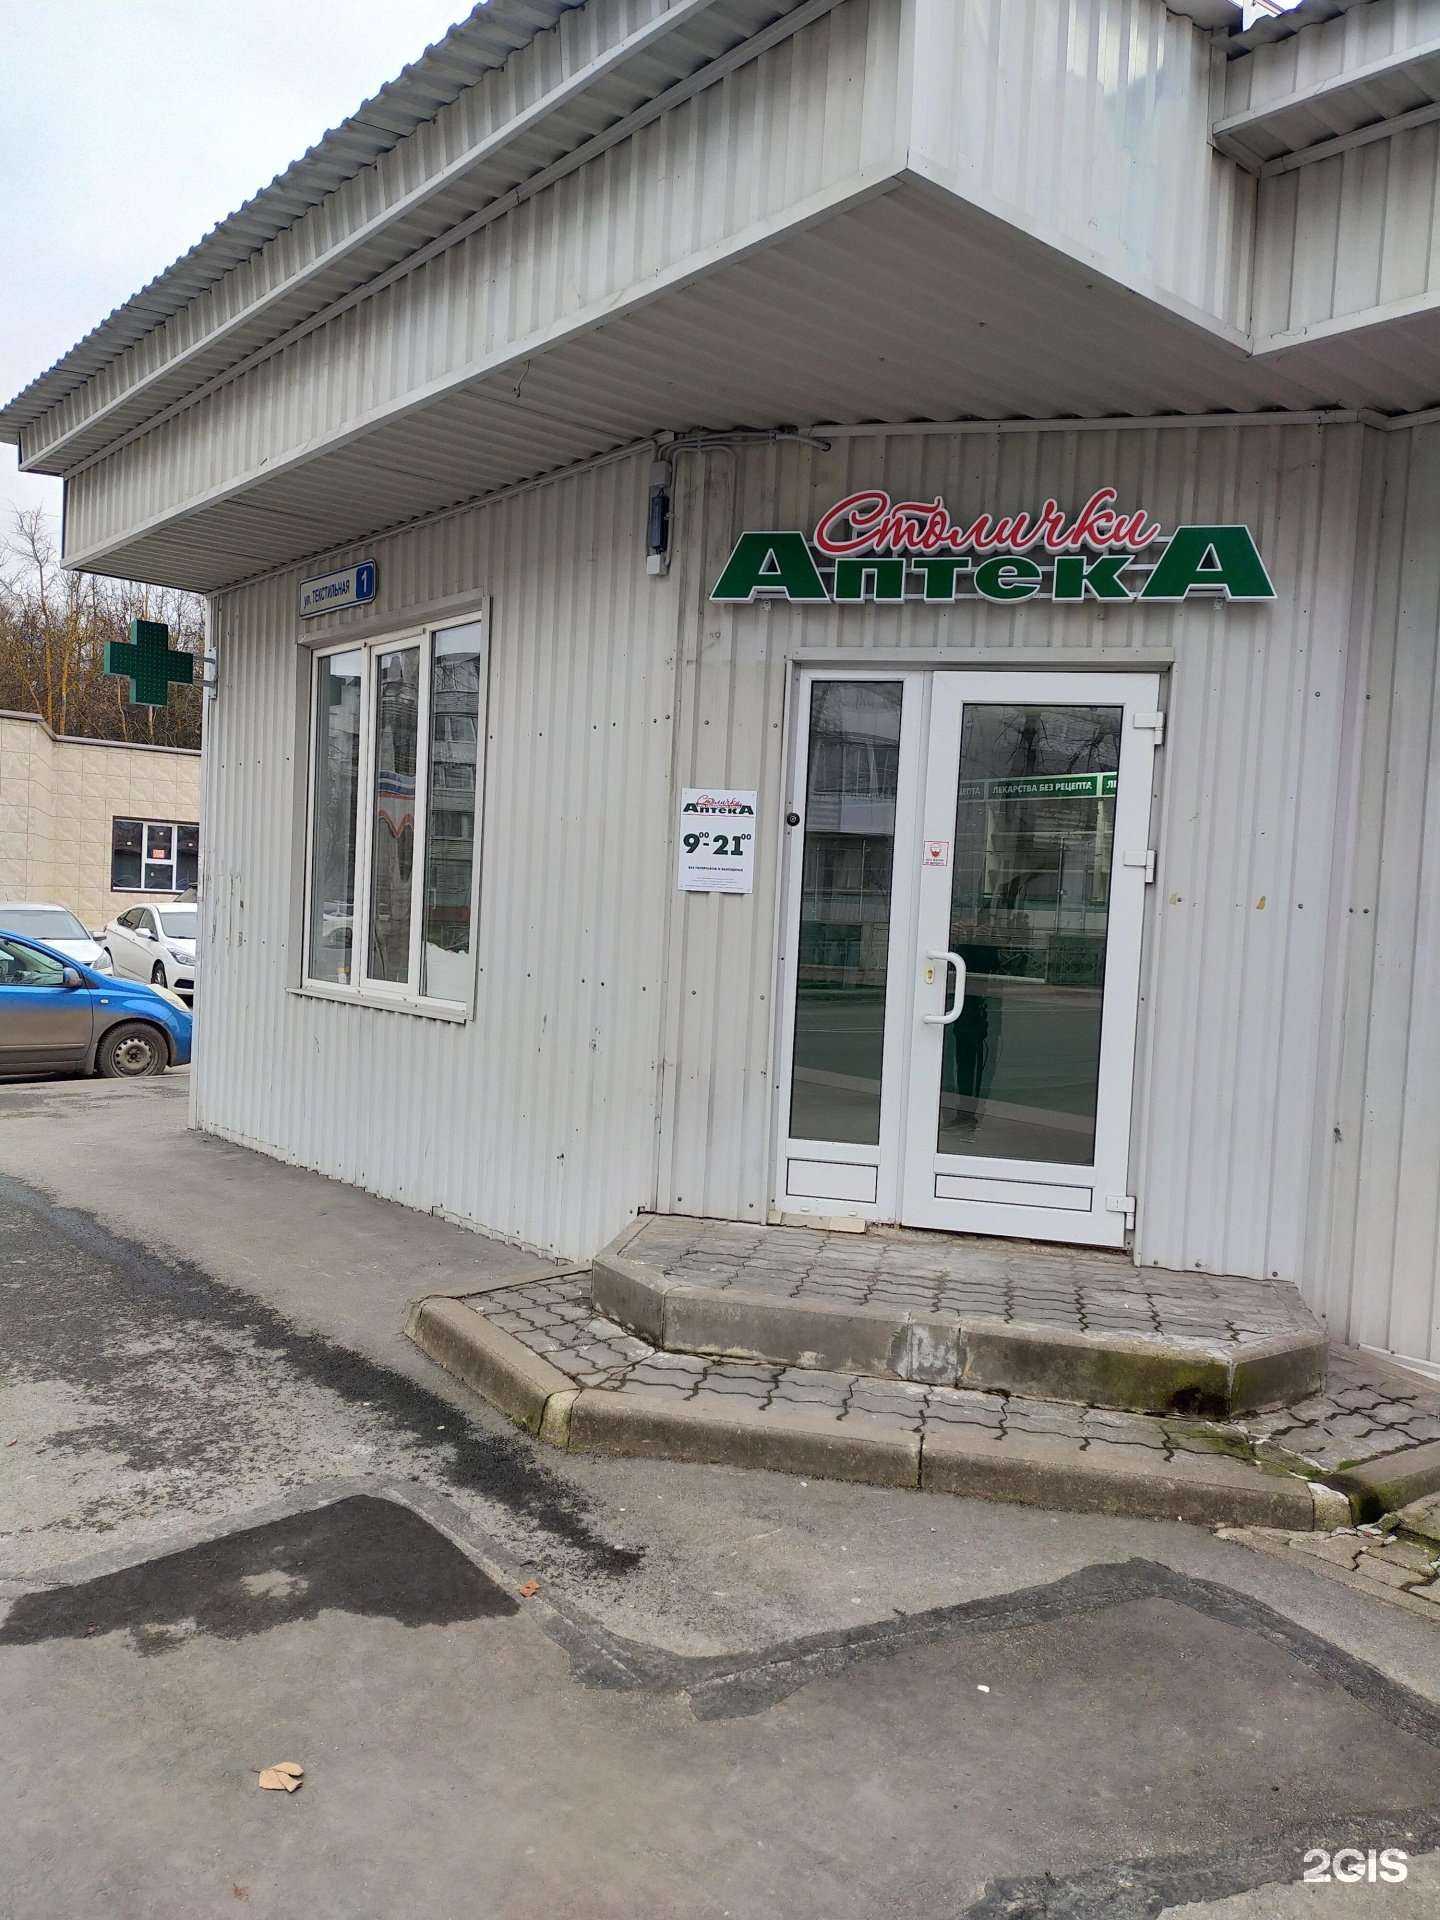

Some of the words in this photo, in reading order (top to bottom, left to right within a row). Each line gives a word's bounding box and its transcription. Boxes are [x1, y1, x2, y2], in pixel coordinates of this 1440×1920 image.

[814, 487, 1161, 556] Столички
[312, 580, 350, 604] ТЕКСТИЛЬНАЯ
[361, 569, 368, 593] 1
[992, 784, 1038, 794] ЛЕКАРСТВА
[1039, 783, 1054, 792] БЕЗ
[1055, 781, 1093, 791] РЕЦЕПТА
